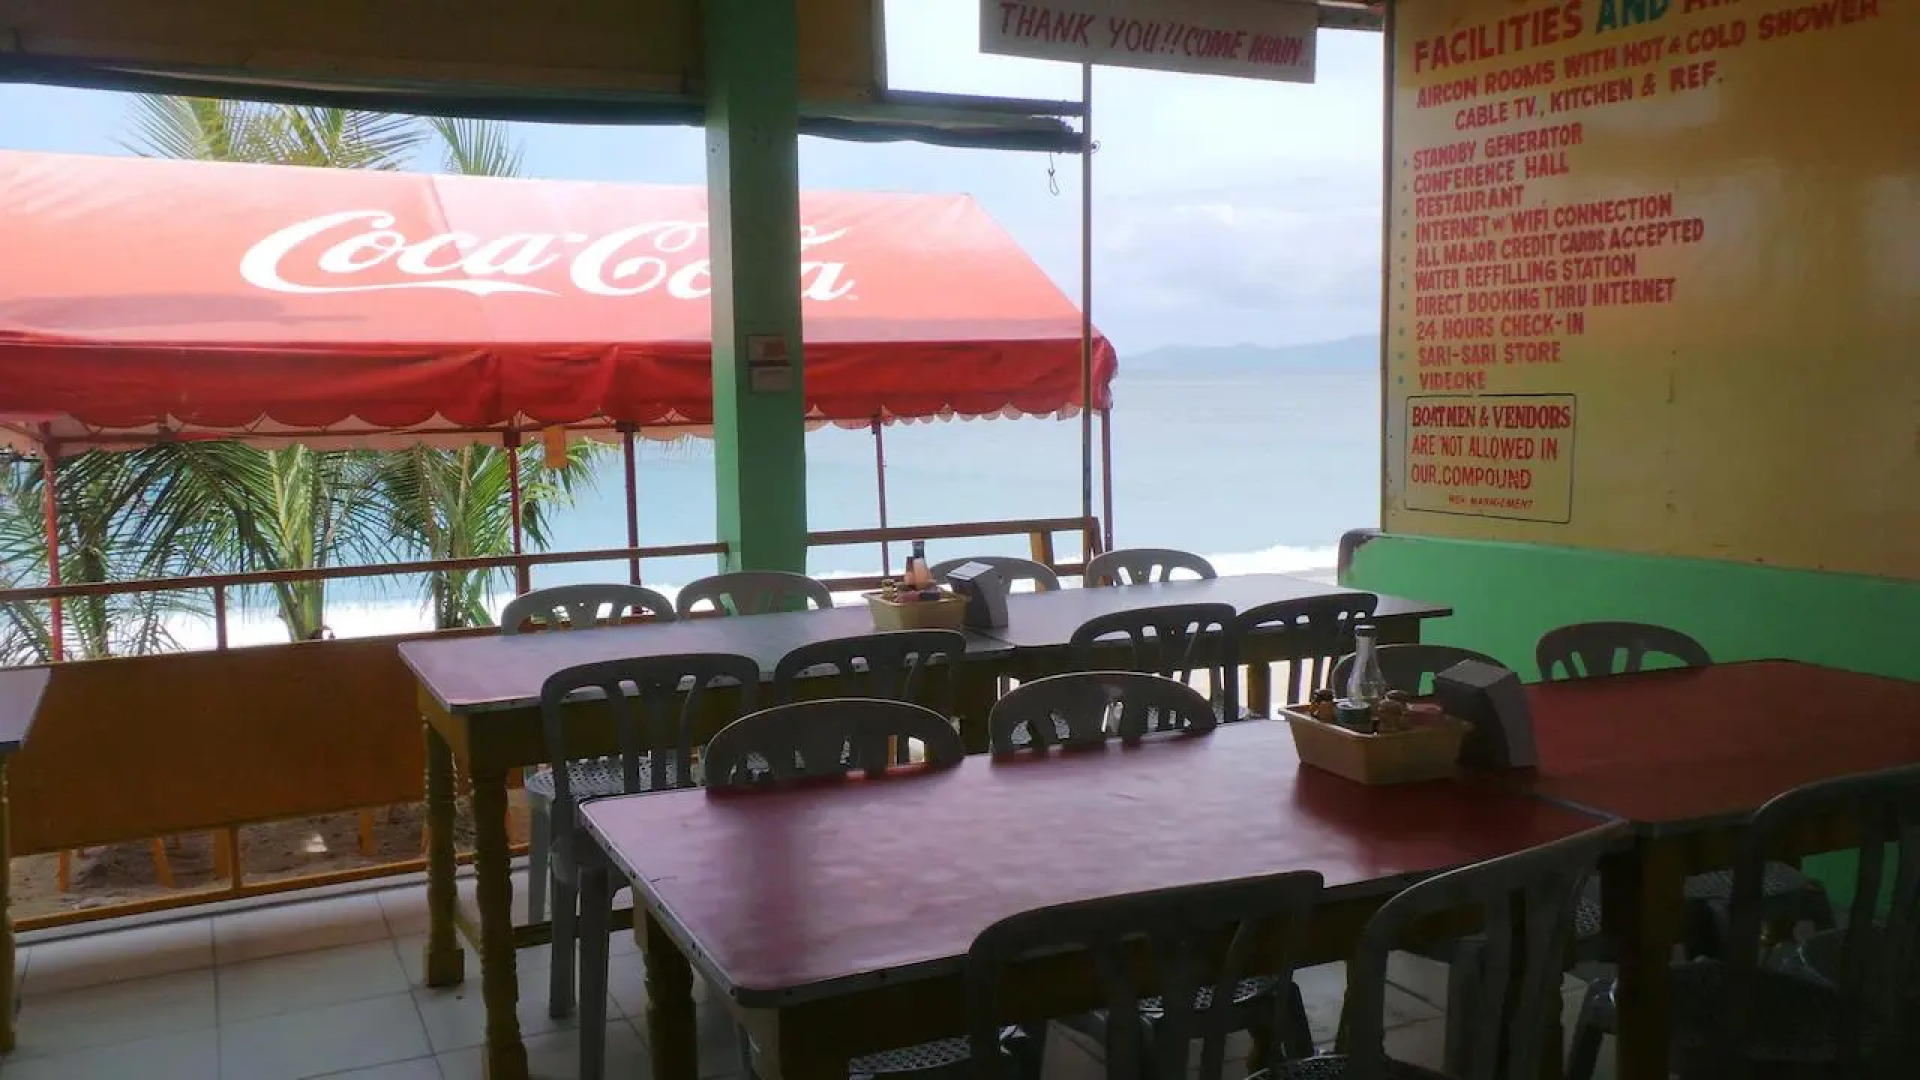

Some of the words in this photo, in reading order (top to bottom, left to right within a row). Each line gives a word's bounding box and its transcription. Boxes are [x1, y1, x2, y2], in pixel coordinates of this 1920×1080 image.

[1000, 4, 1096, 47] THANK
[1413, 2, 1584, 74] FACILITIES
[1595, 0, 1672, 35] AND
[1417, 80, 1477, 109] AIRCON
[1484, 60, 1555, 95] ROOMS
[1564, 44, 1617, 80] WITH
[1623, 35, 1666, 68] HOT
[1686, 20, 1746, 54] COLD
[1758, 0, 1879, 41] SHOWER
[1455, 103, 1507, 131] CABLE
[1550, 79, 1633, 113] KITCHEN
[1641, 74, 1656, 96] &
[1670, 61, 1724, 92] REF.
[1414, 139, 1476, 171] STANDBY
[1484, 122, 1583, 158] GENERATOR
[1414, 160, 1515, 195] CONFERENCE
[1524, 152, 1569, 180] HALL
[1415, 184, 1524, 219] RESTAURANT
[1415, 215, 1489, 243] INTERNET
[1510, 209, 1549, 233] WIFI
[1553, 193, 1673, 229] CONNECTION
[240, 208, 859, 302] Coca-Coa
[1415, 247, 1440, 269] ALL
[1444, 240, 1497, 265] MAJOR
[1502, 234, 1557, 260] CREDIT
[1560, 229, 1605, 254] CARDS
[1609, 217, 1705, 249] ACCEPTED
[1415, 270, 1460, 292] WATER
[1465, 260, 1557, 288] REFFILLING
[1562, 253, 1637, 281] STATION
[1416, 294, 1463, 317] DIRECT
[1468, 288, 1540, 314] BOOKING
[1544, 285, 1588, 310] THRU
[1592, 278, 1676, 307] INTERNET
[1416, 322, 1437, 341] 24
[1442, 317, 1494, 340] HOURS
[1418, 345, 1497, 367] SARI-SARI
[1504, 341, 1561, 364] STORE
[1419, 370, 1487, 392] VIDEOKE
[1412, 405, 1476, 429] BOATMEN
[1479, 406, 1489, 427] &
[1492, 405, 1572, 430] VENDORS
[1411, 435, 1435, 456] ARE
[1440, 436, 1463, 458] NOT
[1468, 436, 1535, 461] ALLOWED
[1541, 437, 1558, 461] IN
[1443, 465, 1533, 490] COMPOUND
